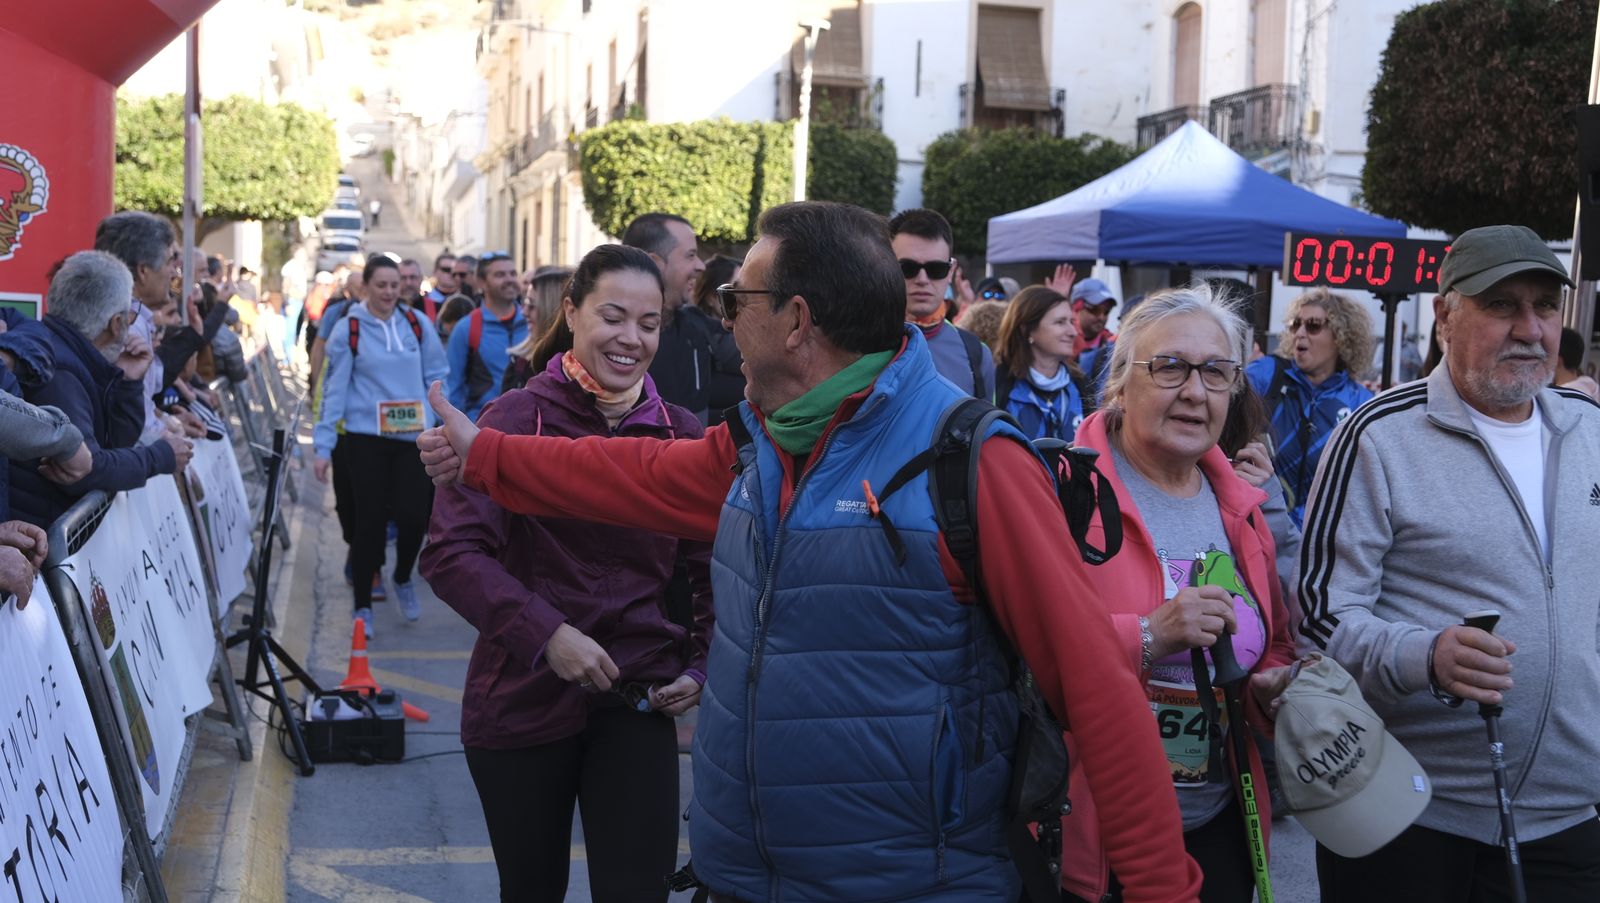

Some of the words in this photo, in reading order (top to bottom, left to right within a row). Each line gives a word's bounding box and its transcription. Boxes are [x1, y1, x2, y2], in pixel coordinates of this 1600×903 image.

[386, 408, 416, 419] 496
[1296, 720, 1367, 784] OLYMPIA
[1240, 772, 1259, 816] 300
